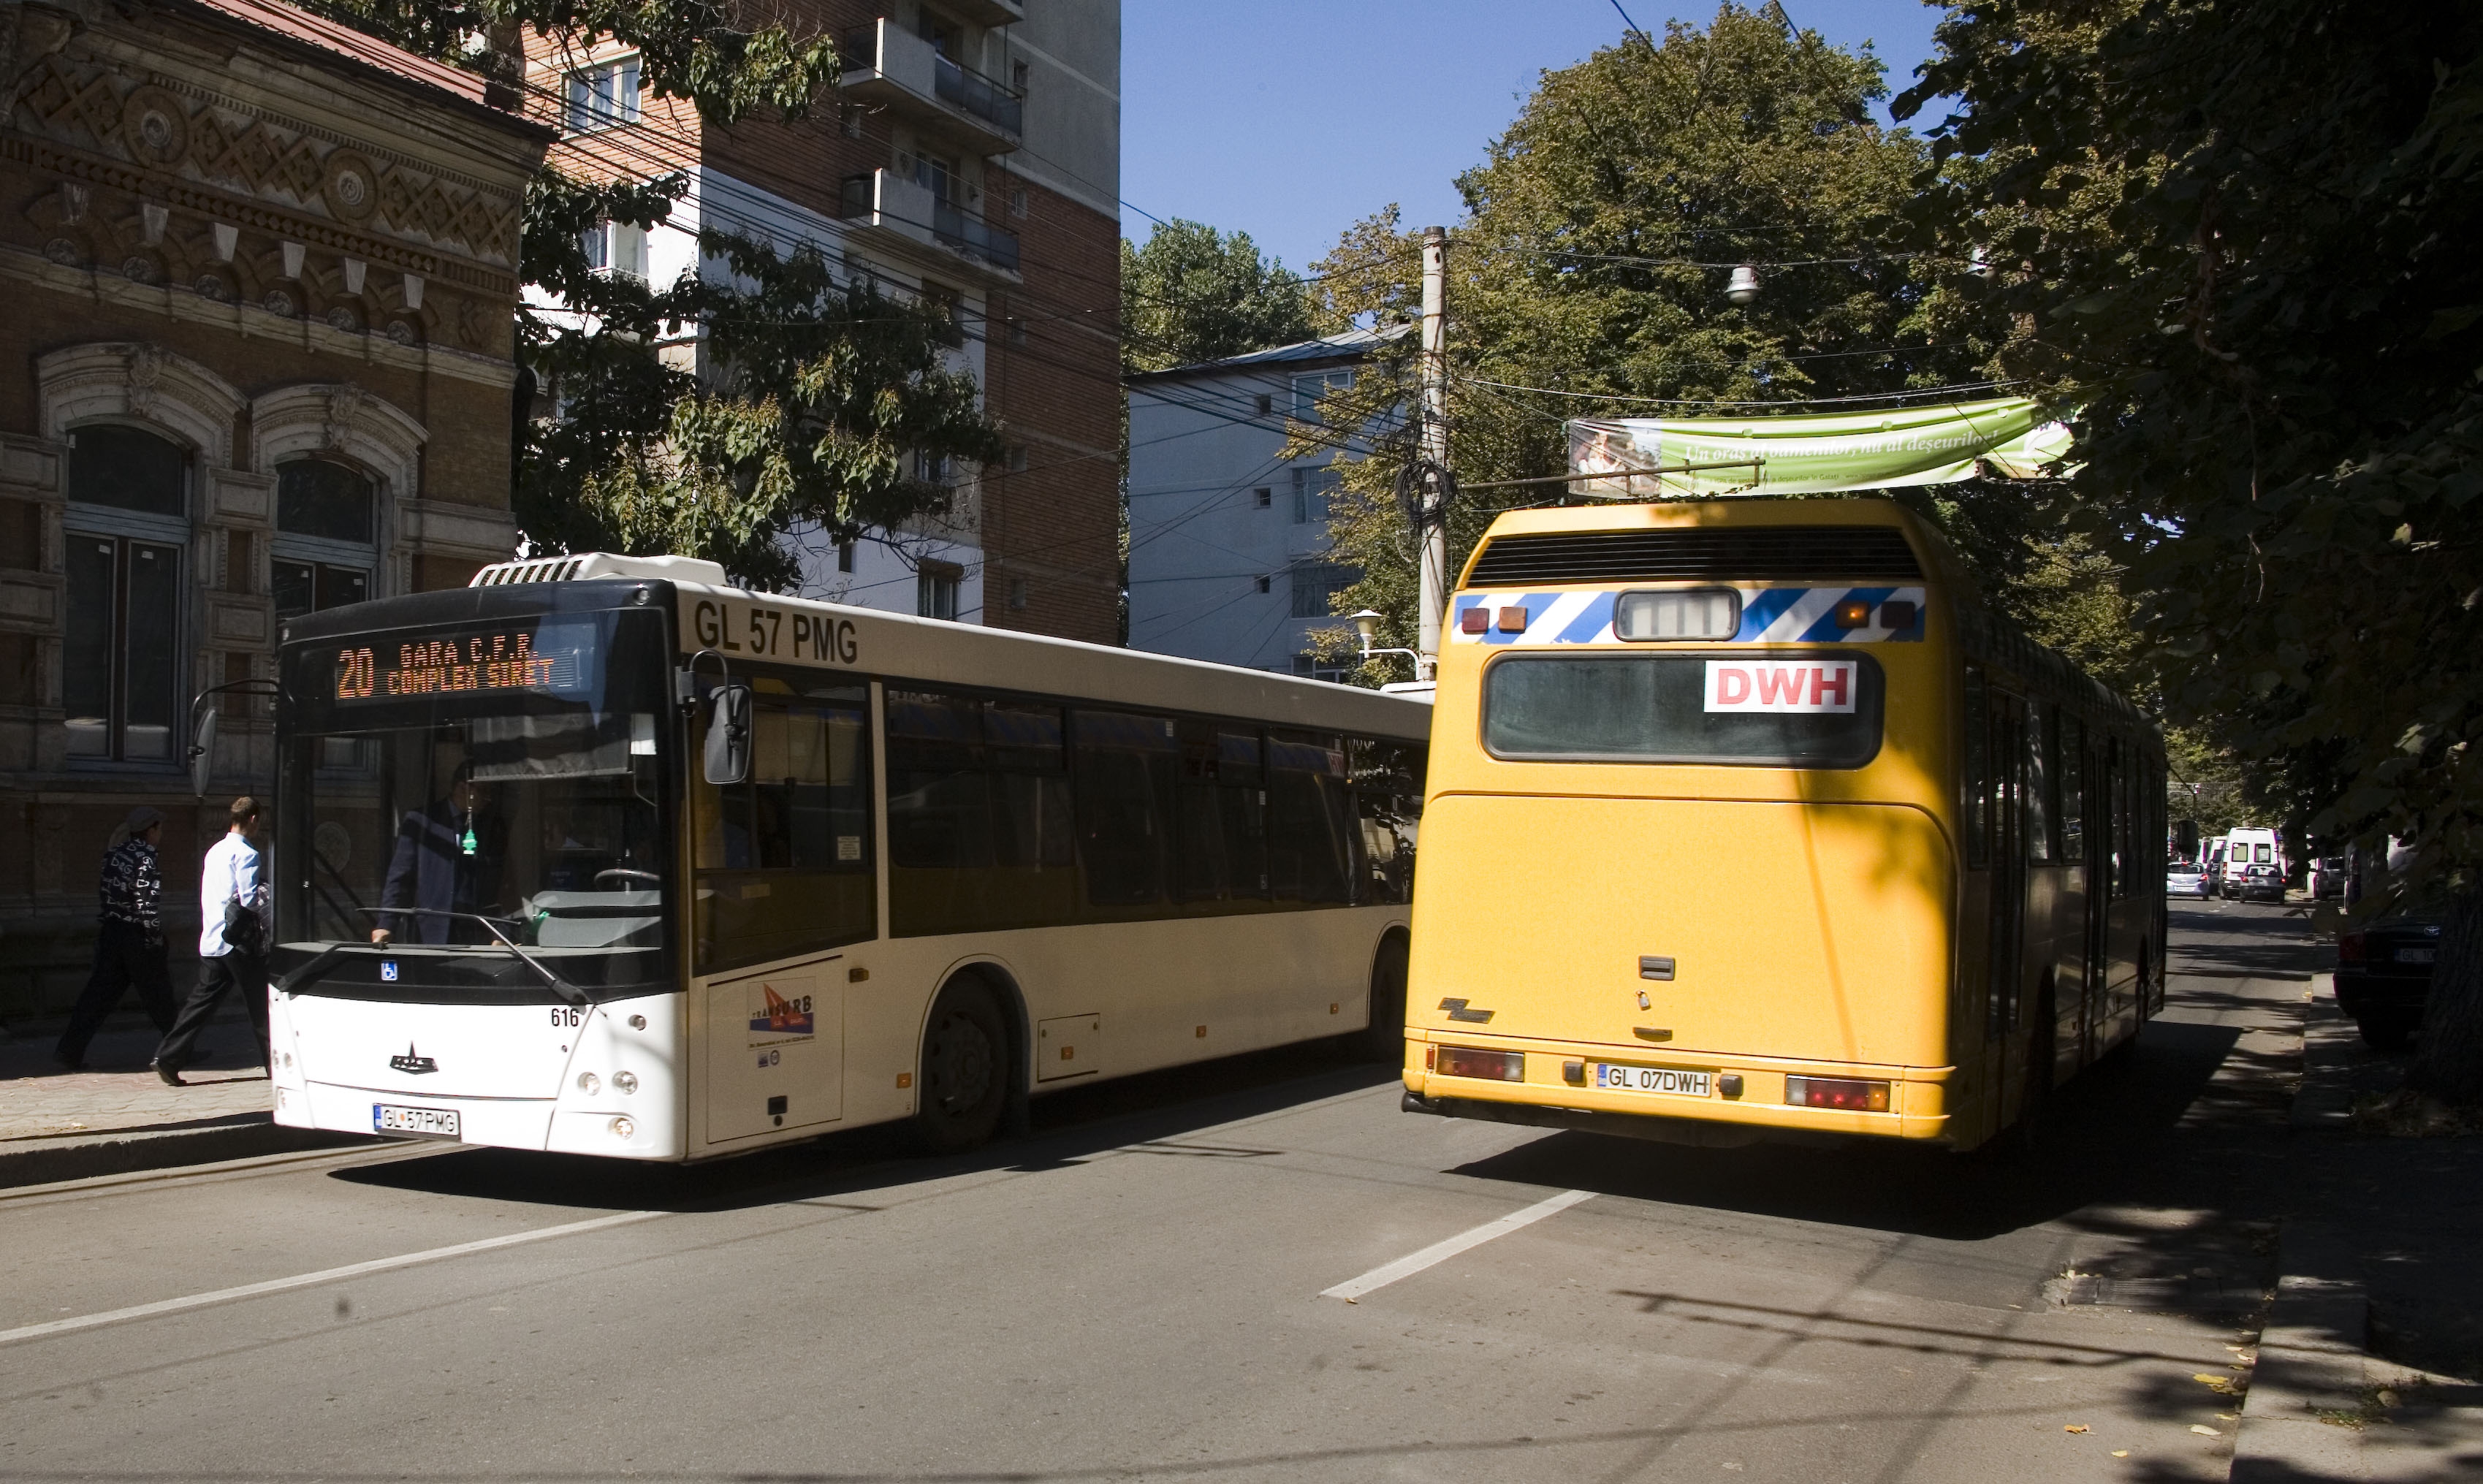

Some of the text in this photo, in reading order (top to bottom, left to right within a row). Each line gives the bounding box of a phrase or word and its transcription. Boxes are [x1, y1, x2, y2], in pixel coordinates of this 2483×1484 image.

[1685, 446, 1709, 461] Un
[1860, 441, 1883, 454] nu
[1886, 436, 1903, 452] al
[695, 600, 858, 664] GL 57 PMG
[400, 633, 539, 668] GARA C.F.R.
[338, 647, 374, 699] 20
[388, 658, 554, 695] COMPLEX SIRET
[1717, 668, 1848, 706] DWH
[552, 1008, 579, 1027] 616
[752, 995, 812, 1019] TRANSURB
[1609, 1068, 1632, 1087] GL
[384, 1109, 401, 1128] GL
